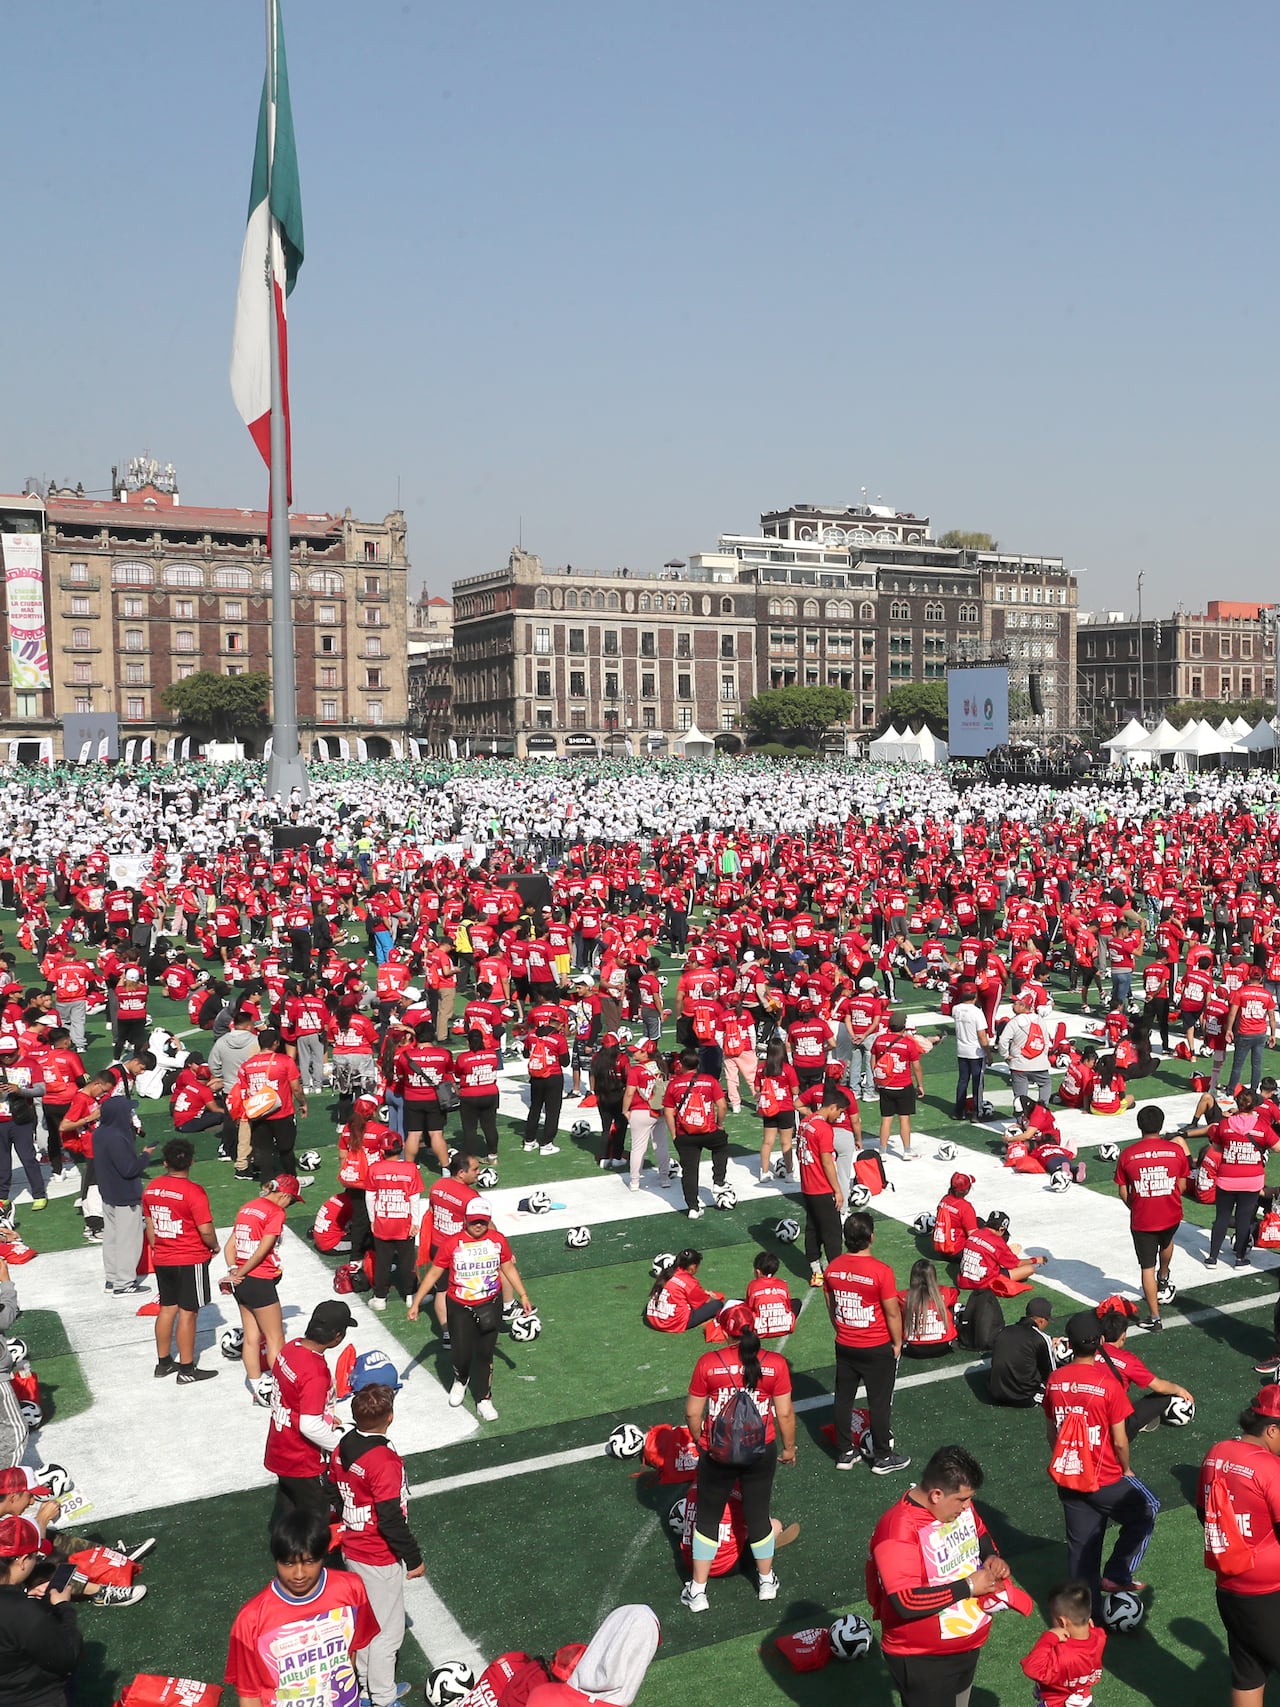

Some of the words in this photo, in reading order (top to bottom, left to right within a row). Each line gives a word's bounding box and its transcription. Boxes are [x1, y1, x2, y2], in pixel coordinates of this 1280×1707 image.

[1140, 1171, 1167, 1181] FUTBOL
[467, 1247, 488, 1257] 7328
[457, 1263, 467, 1271] LA
[841, 1290, 858, 1299] CLASE
[760, 1309, 787, 1319] FUTBOL
[842, 1305, 876, 1322] GRANDE
[940, 1554, 965, 1576] VUELVE
[279, 1659, 296, 1674] LA
[280, 1665, 317, 1687] VUELVE
[320, 1662, 328, 1672] A
